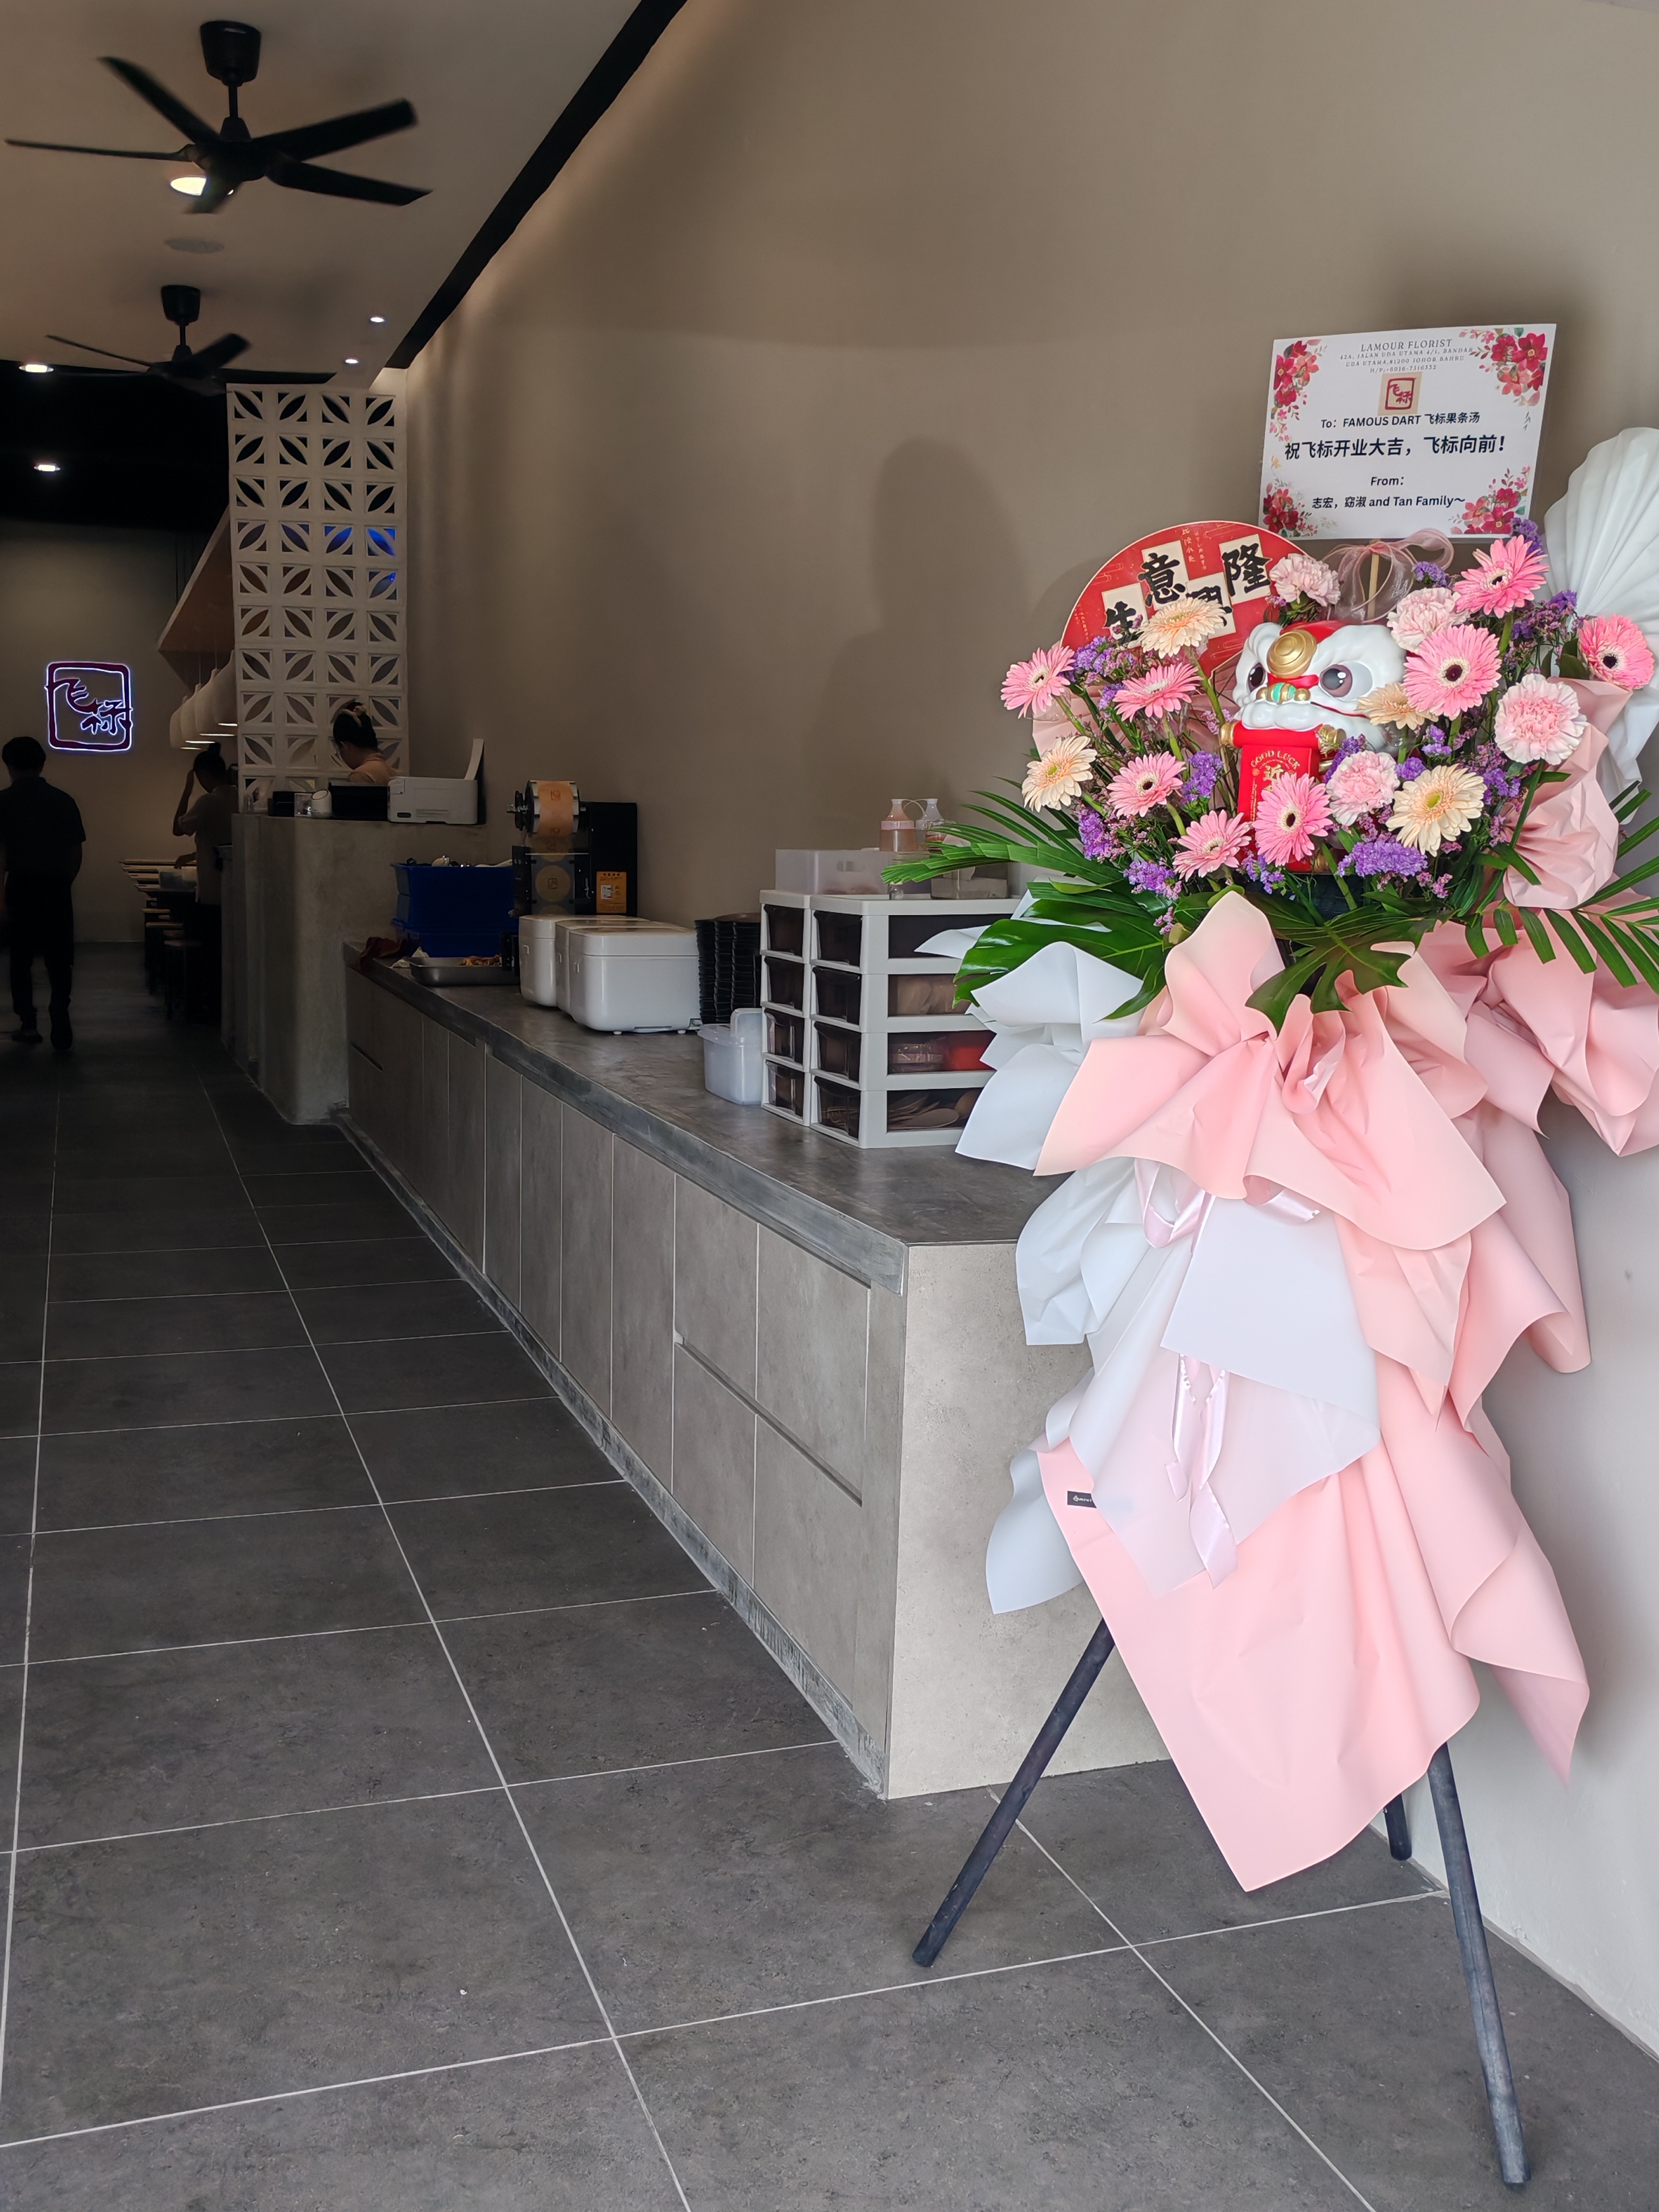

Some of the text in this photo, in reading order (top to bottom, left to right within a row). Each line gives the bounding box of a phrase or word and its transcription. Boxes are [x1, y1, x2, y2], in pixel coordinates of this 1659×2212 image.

[1361, 339, 1453, 352] LAMOUR FLORIST
[1343, 416, 1389, 428] FAMOUS
[1391, 415, 1421, 426] DART
[1424, 412, 1481, 425] 飞标果条汤
[1369, 496, 1390, 507] and
[1393, 496, 1412, 507] Tan
[1251, 750, 1274, 768] GOOD
[1277, 750, 1300, 770] LUCK
